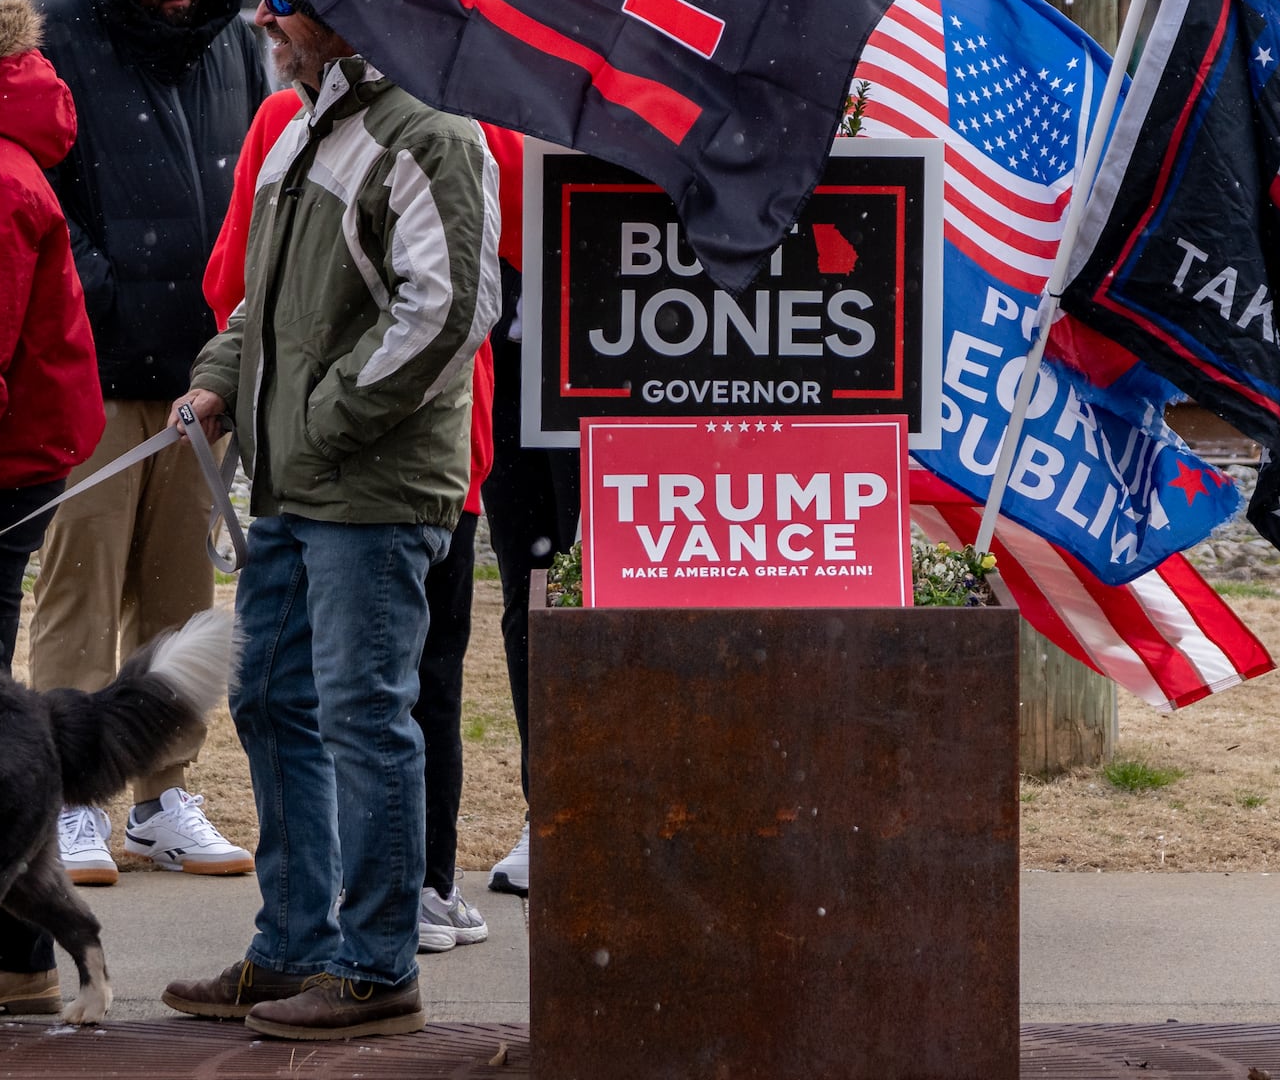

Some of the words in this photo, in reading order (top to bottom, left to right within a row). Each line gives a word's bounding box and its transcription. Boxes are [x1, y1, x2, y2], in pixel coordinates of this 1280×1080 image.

[588, 288, 876, 357] JONES
[642, 380, 822, 404] GOVERNOR
[603, 472, 888, 523] TRUMP
[636, 523, 857, 563] VANCE
[621, 567, 669, 579] MAKE
[674, 566, 750, 578] AMERICA
[755, 566, 809, 577] GREAT
[815, 565, 874, 576] AGAIN!
